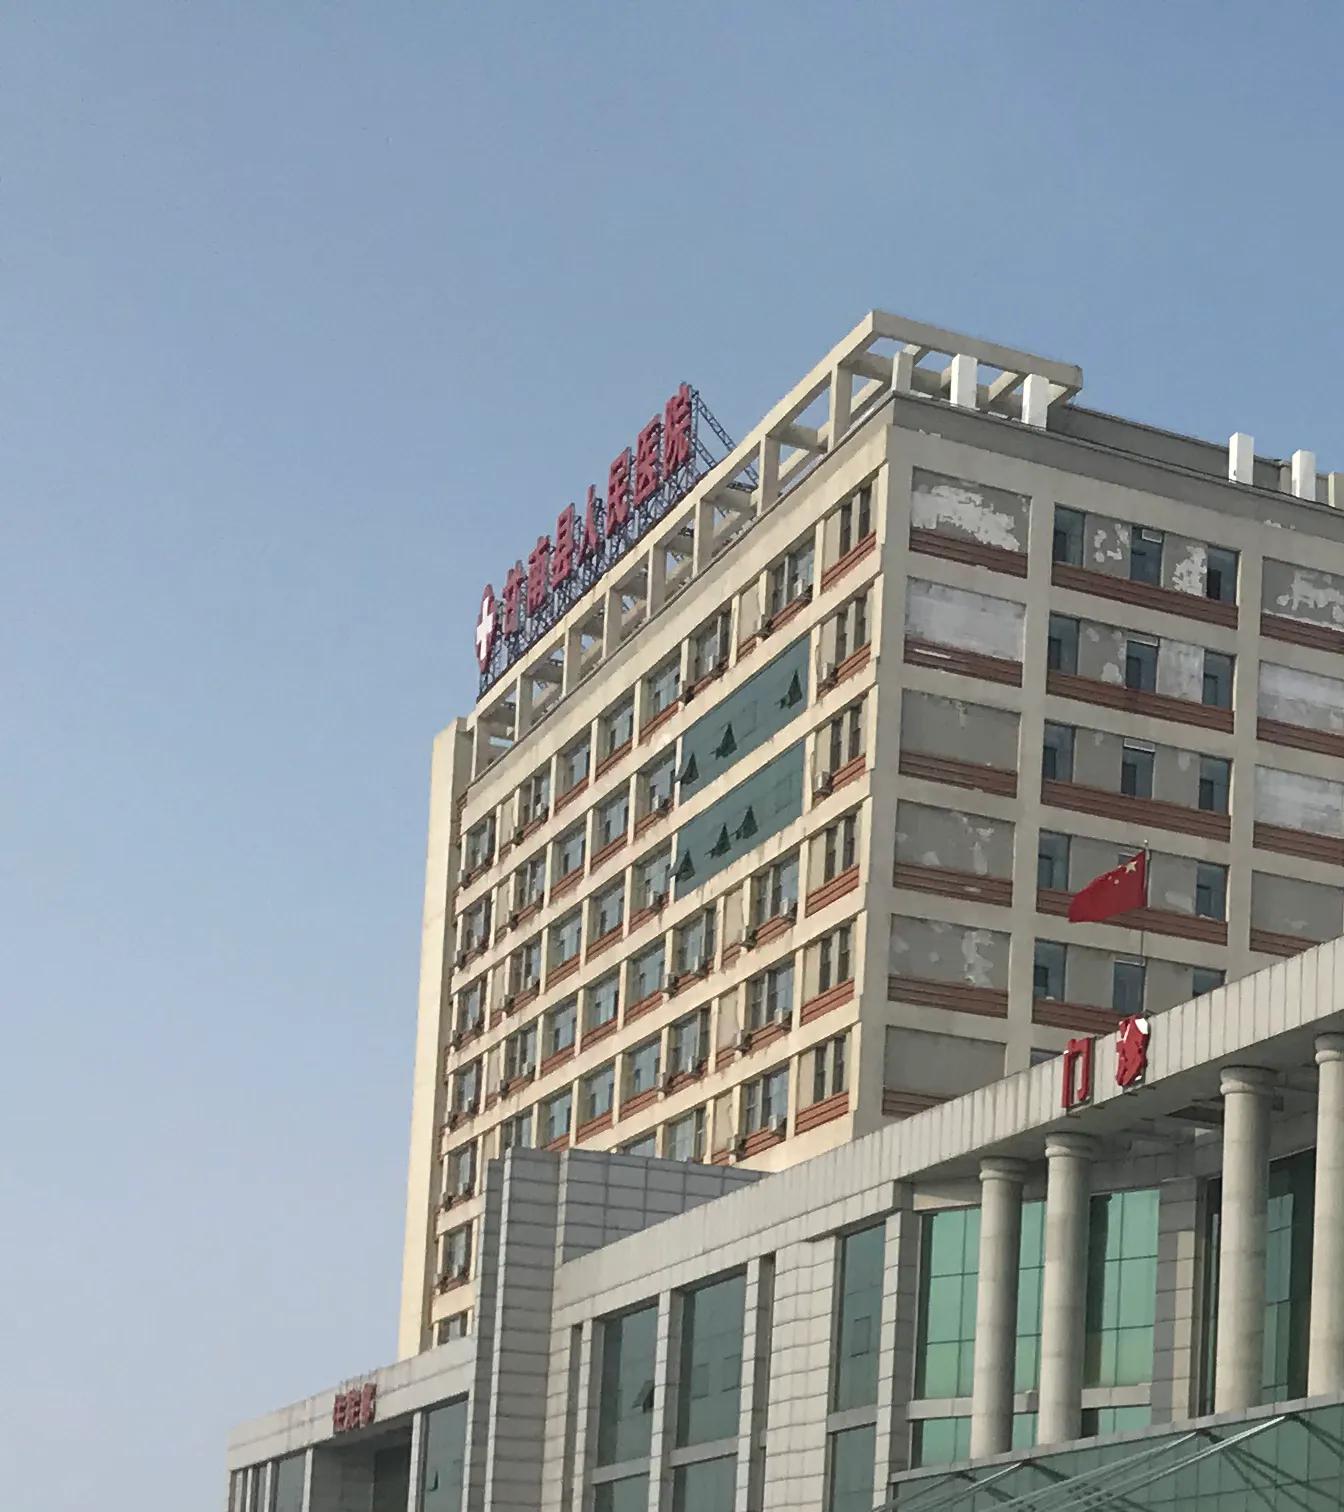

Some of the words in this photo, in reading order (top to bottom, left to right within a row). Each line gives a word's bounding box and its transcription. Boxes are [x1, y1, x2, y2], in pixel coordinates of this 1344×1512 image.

[502, 382, 693, 638] 甘南县人民医院
